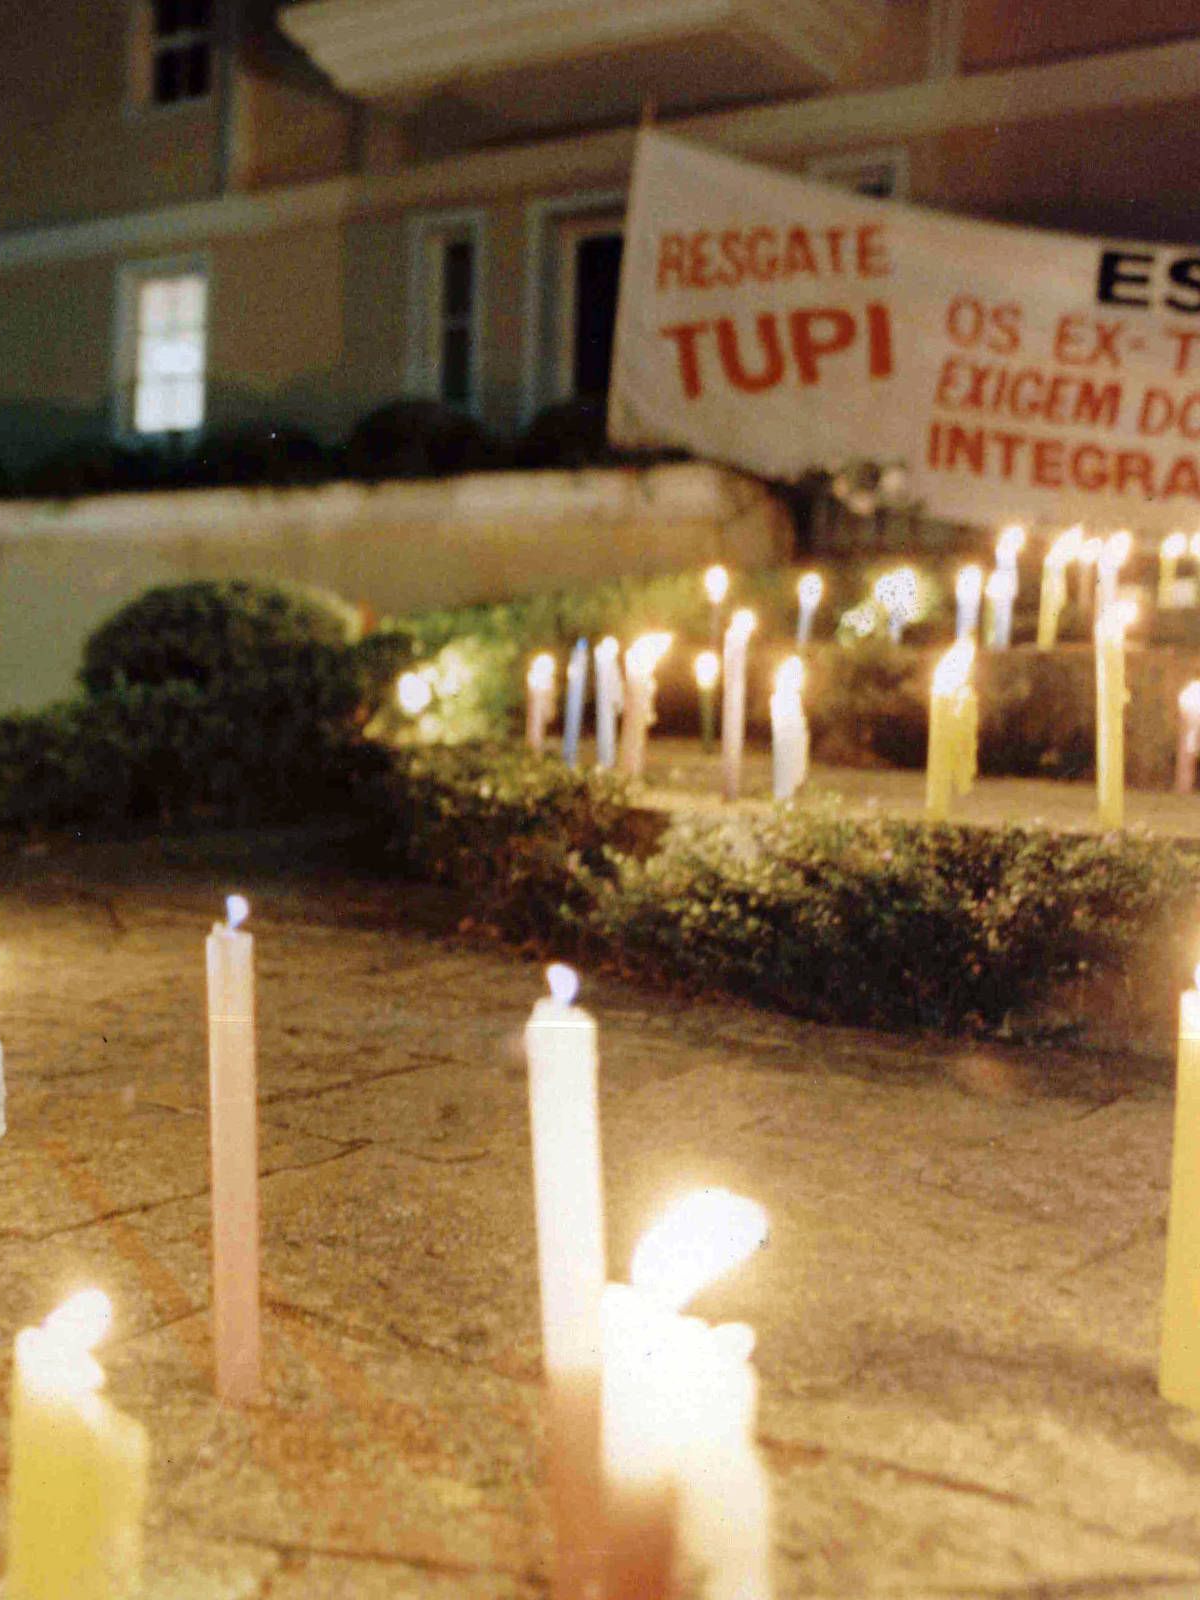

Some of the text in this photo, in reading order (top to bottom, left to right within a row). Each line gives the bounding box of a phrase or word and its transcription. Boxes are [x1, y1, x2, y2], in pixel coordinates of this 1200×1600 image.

[656, 224, 892, 290] RESGATE
[1097, 251, 1200, 314] ES
[659, 302, 893, 399] TUPI
[945, 294, 1022, 356] OS
[934, 354, 1122, 430] EXIGEM
[927, 422, 1200, 500] INTEGRA
